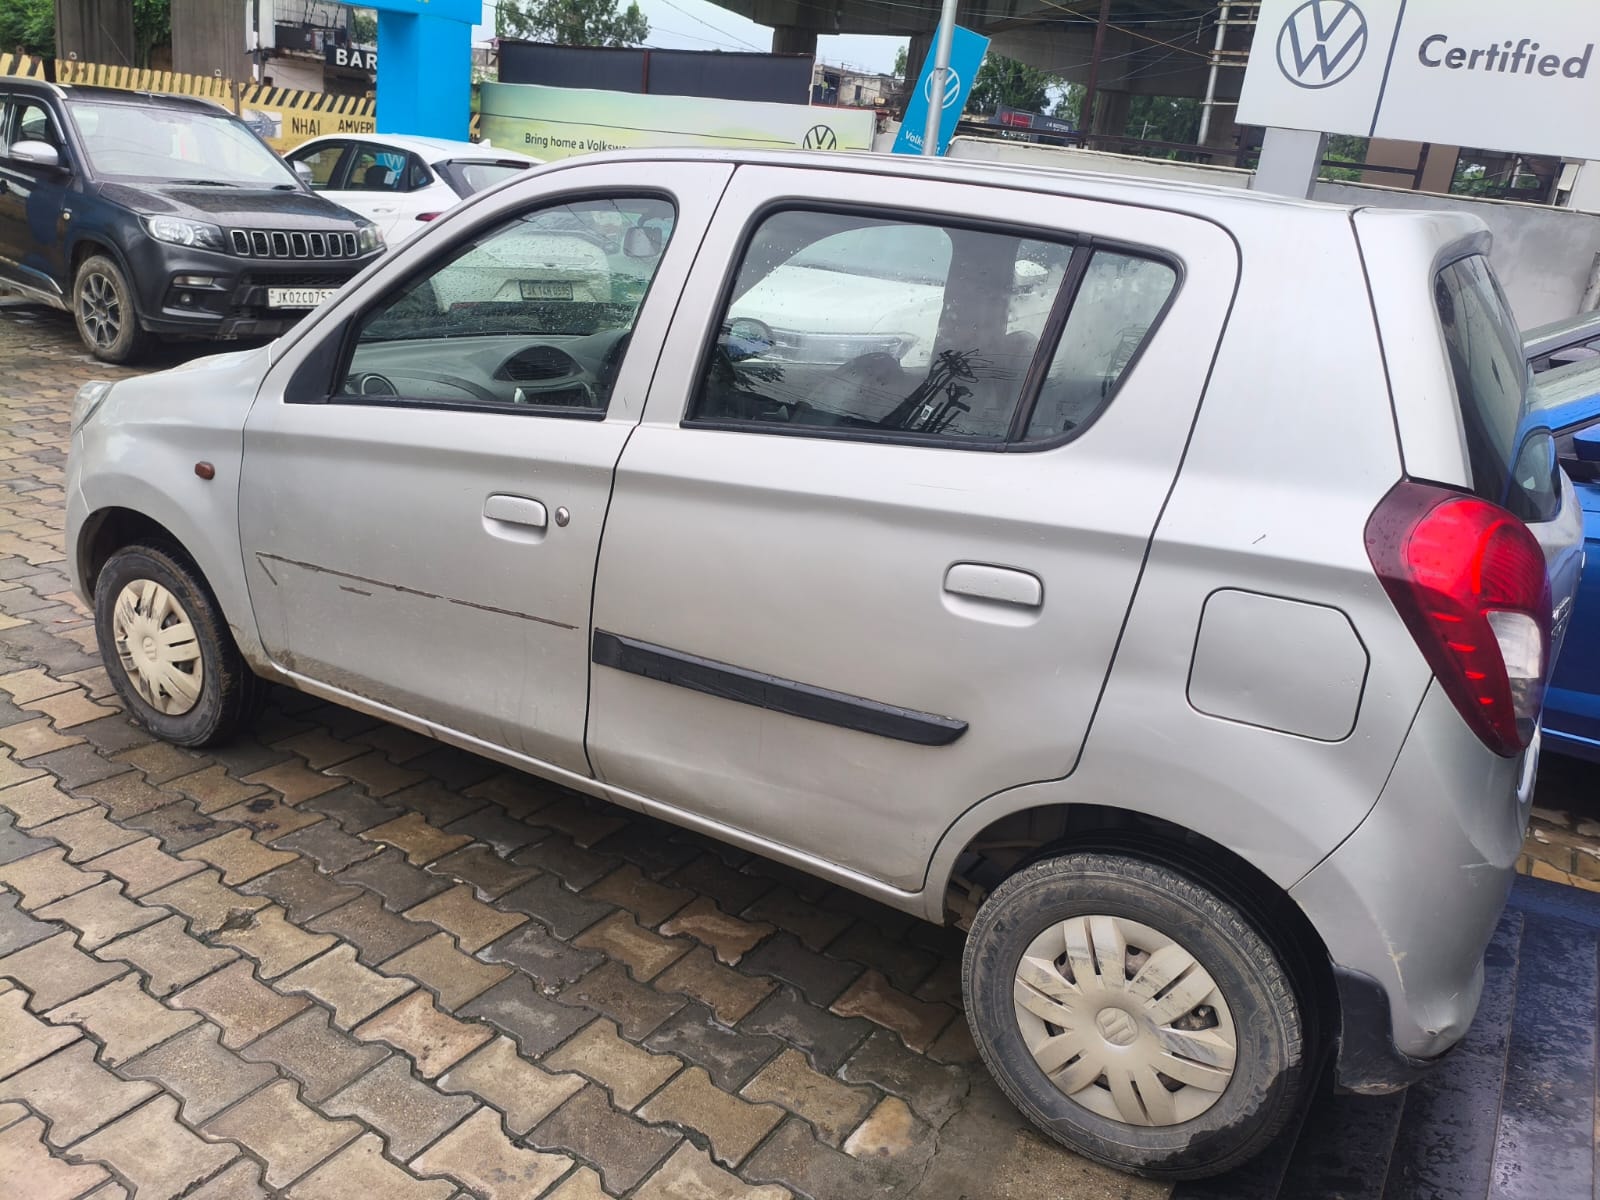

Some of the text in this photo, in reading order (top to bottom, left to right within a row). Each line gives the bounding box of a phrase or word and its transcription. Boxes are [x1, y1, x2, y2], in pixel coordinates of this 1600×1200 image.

[336, 48, 378, 70] BAR
[1418, 34, 1594, 79] Certified
[292, 117, 321, 136] NHAI
[525, 132, 549, 149] Bring
[550, 136, 577, 150] home
[578, 140, 585, 150] a
[276, 291, 334, 304] JK02CD75
